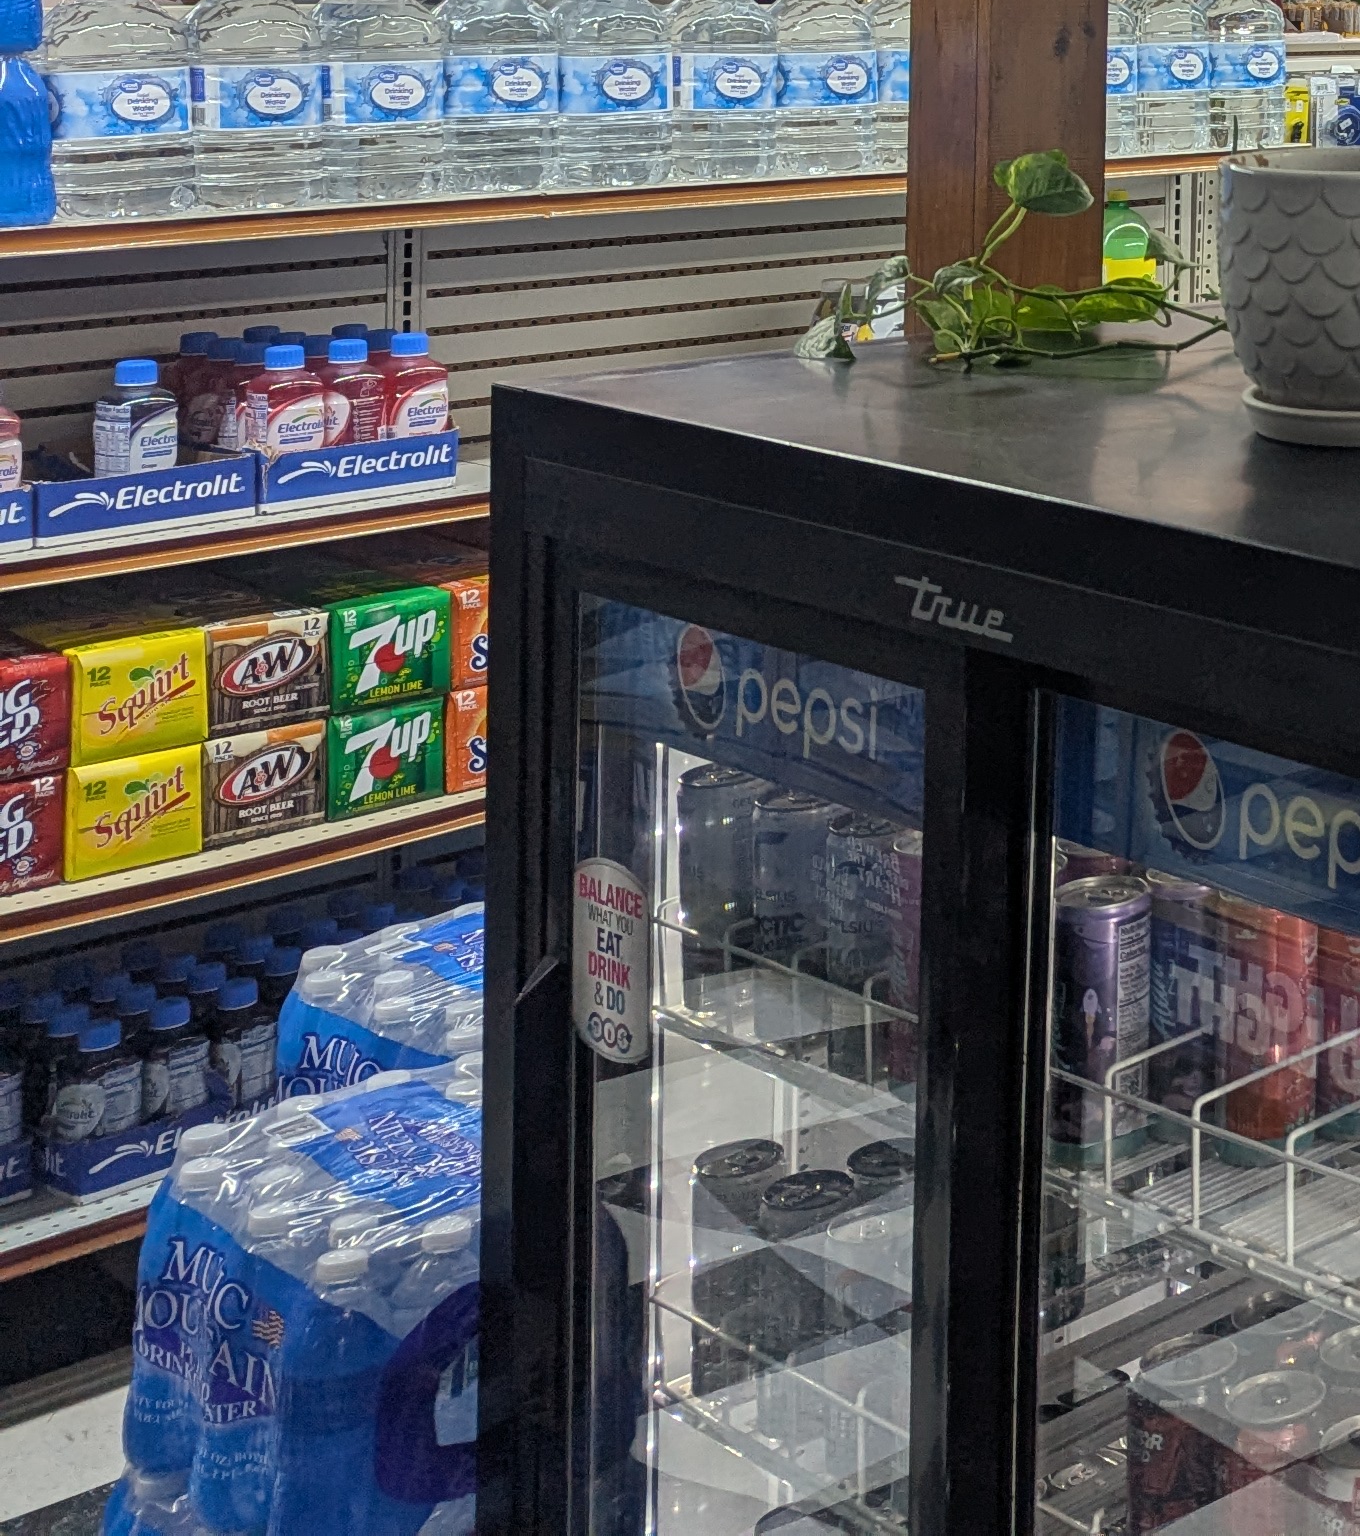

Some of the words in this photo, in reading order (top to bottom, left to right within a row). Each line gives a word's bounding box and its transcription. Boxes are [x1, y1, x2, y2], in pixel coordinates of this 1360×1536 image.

[335, 443, 452, 479] Electrolit
[114, 471, 246, 511] Electrolit
[459, 589, 481, 605] 12
[303, 617, 321, 631] 12
[343, 610, 358, 622] 12
[87, 665, 112, 682] 12
[236, 638, 300, 690] A&W
[89, 680, 112, 688] PACK
[97, 652, 191, 736] Squirt
[369, 682, 401, 698] LEMON
[402, 679, 424, 693] LIME
[0, 679, 32, 712] IG
[242, 697, 271, 710] ROOT
[273, 692, 299, 705] BEER
[455, 690, 477, 705] 12
[339, 717, 353, 728] 12
[735, 668, 878, 761] pepsi
[0, 705, 40, 749] ED
[213, 741, 233, 755] 12
[235, 745, 298, 801] A&W
[31, 776, 56, 793] 12
[82, 780, 108, 796] 12
[363, 790, 395, 805] LEMON
[395, 784, 417, 797] LIME
[85, 793, 106, 802] PACK
[94, 765, 186, 850] Squirt
[238, 805, 268, 819] ROOT
[269, 800, 295, 812] BEER
[578, 873, 643, 920] BALANCE
[587, 902, 613, 928] WHAT
[615, 914, 634, 936] YOU
[587, 950, 631, 991] DRINK
[594, 981, 604, 1008] &
[606, 985, 626, 1015] DO
